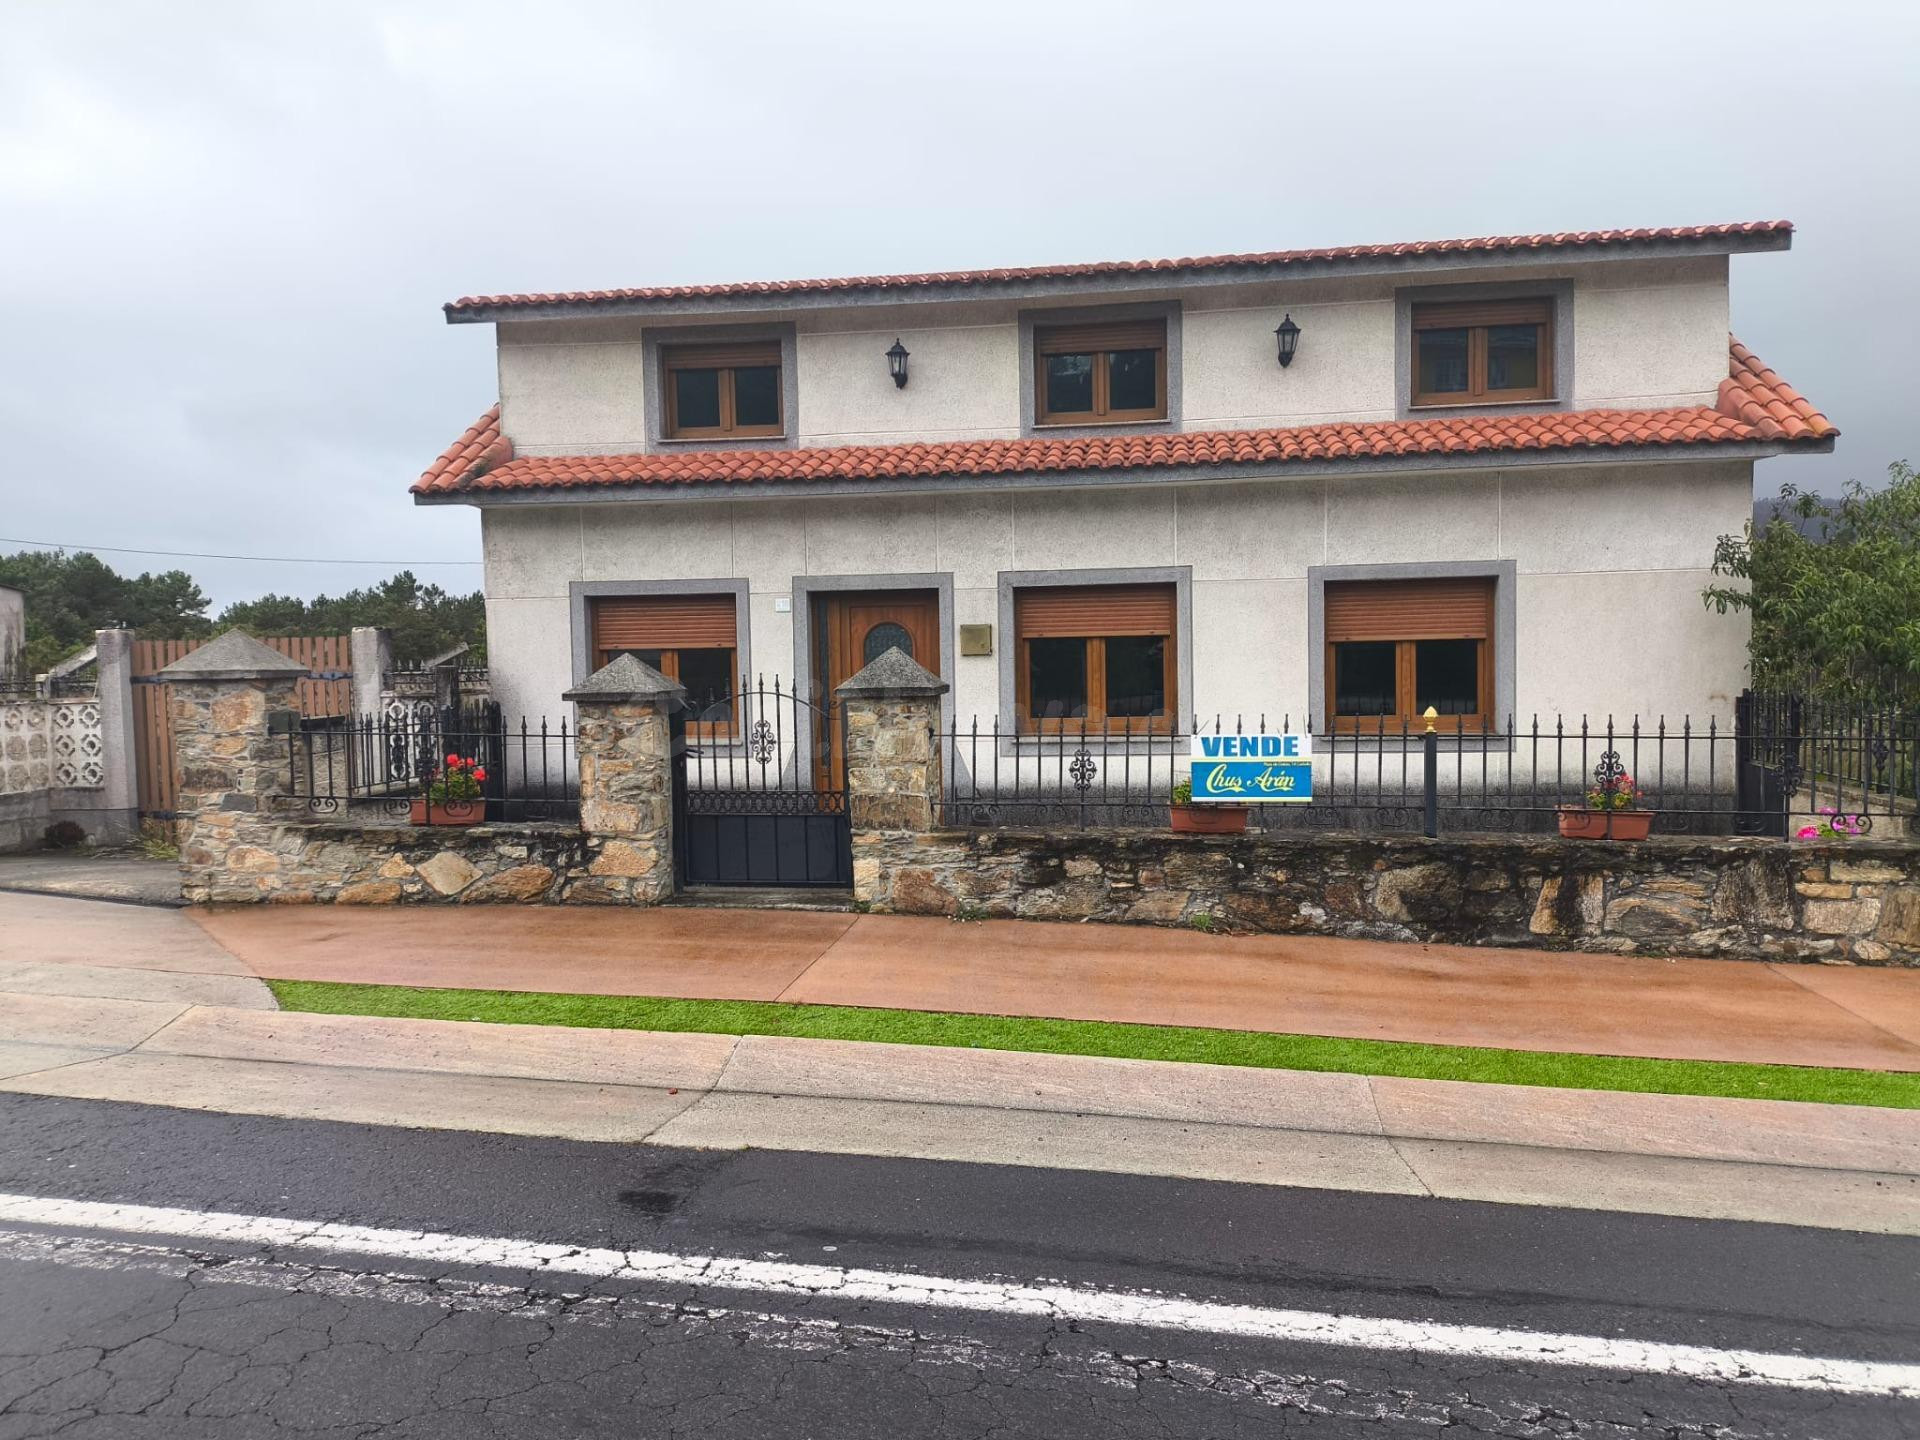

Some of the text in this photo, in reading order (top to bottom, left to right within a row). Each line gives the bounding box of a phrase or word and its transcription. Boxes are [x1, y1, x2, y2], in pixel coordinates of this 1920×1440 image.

[1200, 736, 1299, 757] VENDE
[1206, 763, 1296, 793] Chus Arán
